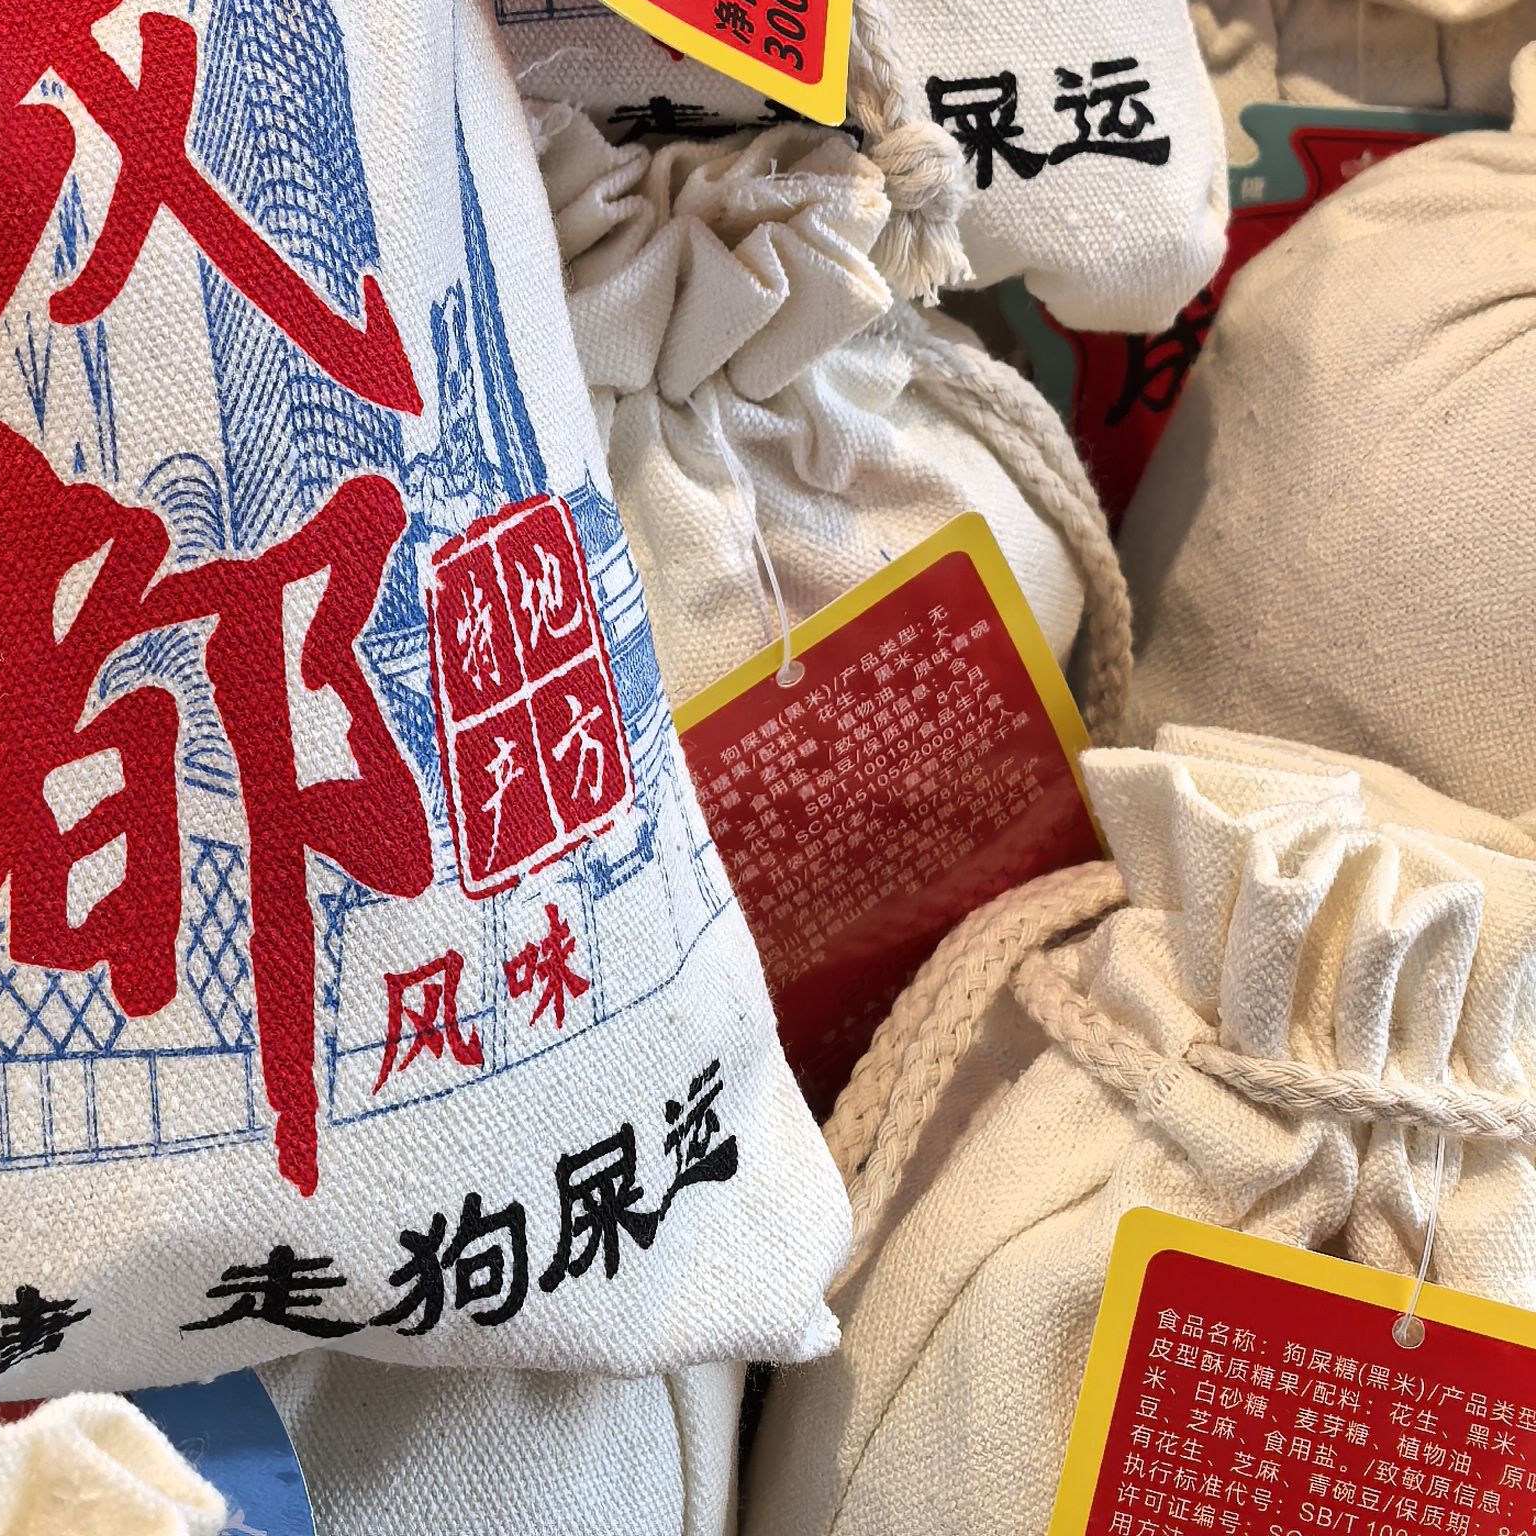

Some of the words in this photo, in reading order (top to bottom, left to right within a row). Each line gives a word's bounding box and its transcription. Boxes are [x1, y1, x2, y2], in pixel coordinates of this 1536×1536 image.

[372, 903, 591, 1096] 风味
[180, 1060, 743, 1339] 走狗屎运
[1135, 1393, 1536, 1526] 豆、芝麻、食用盐。/致敏原信息：
